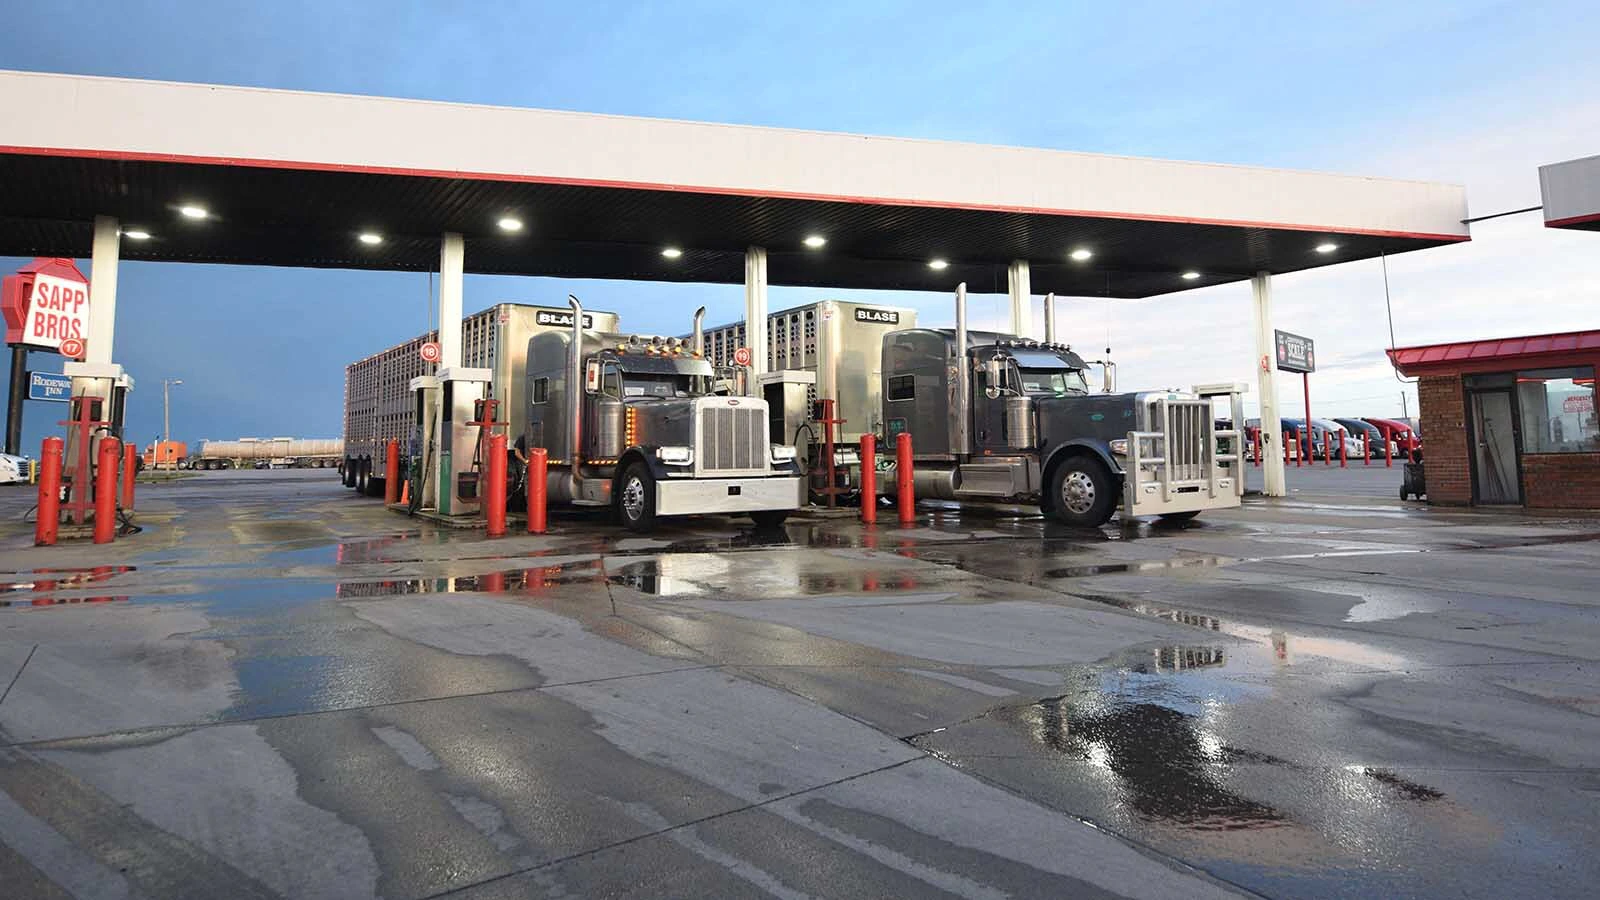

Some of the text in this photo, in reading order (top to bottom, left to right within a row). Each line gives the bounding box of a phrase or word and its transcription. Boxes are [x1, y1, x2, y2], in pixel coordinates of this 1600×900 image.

[37, 282, 85, 314] SAPP
[857, 310, 897, 322] BLASE
[33, 311, 81, 341] BROS
[66, 343, 78, 353] 17
[424, 347, 435, 357] 18
[44, 385, 63, 397] INN
